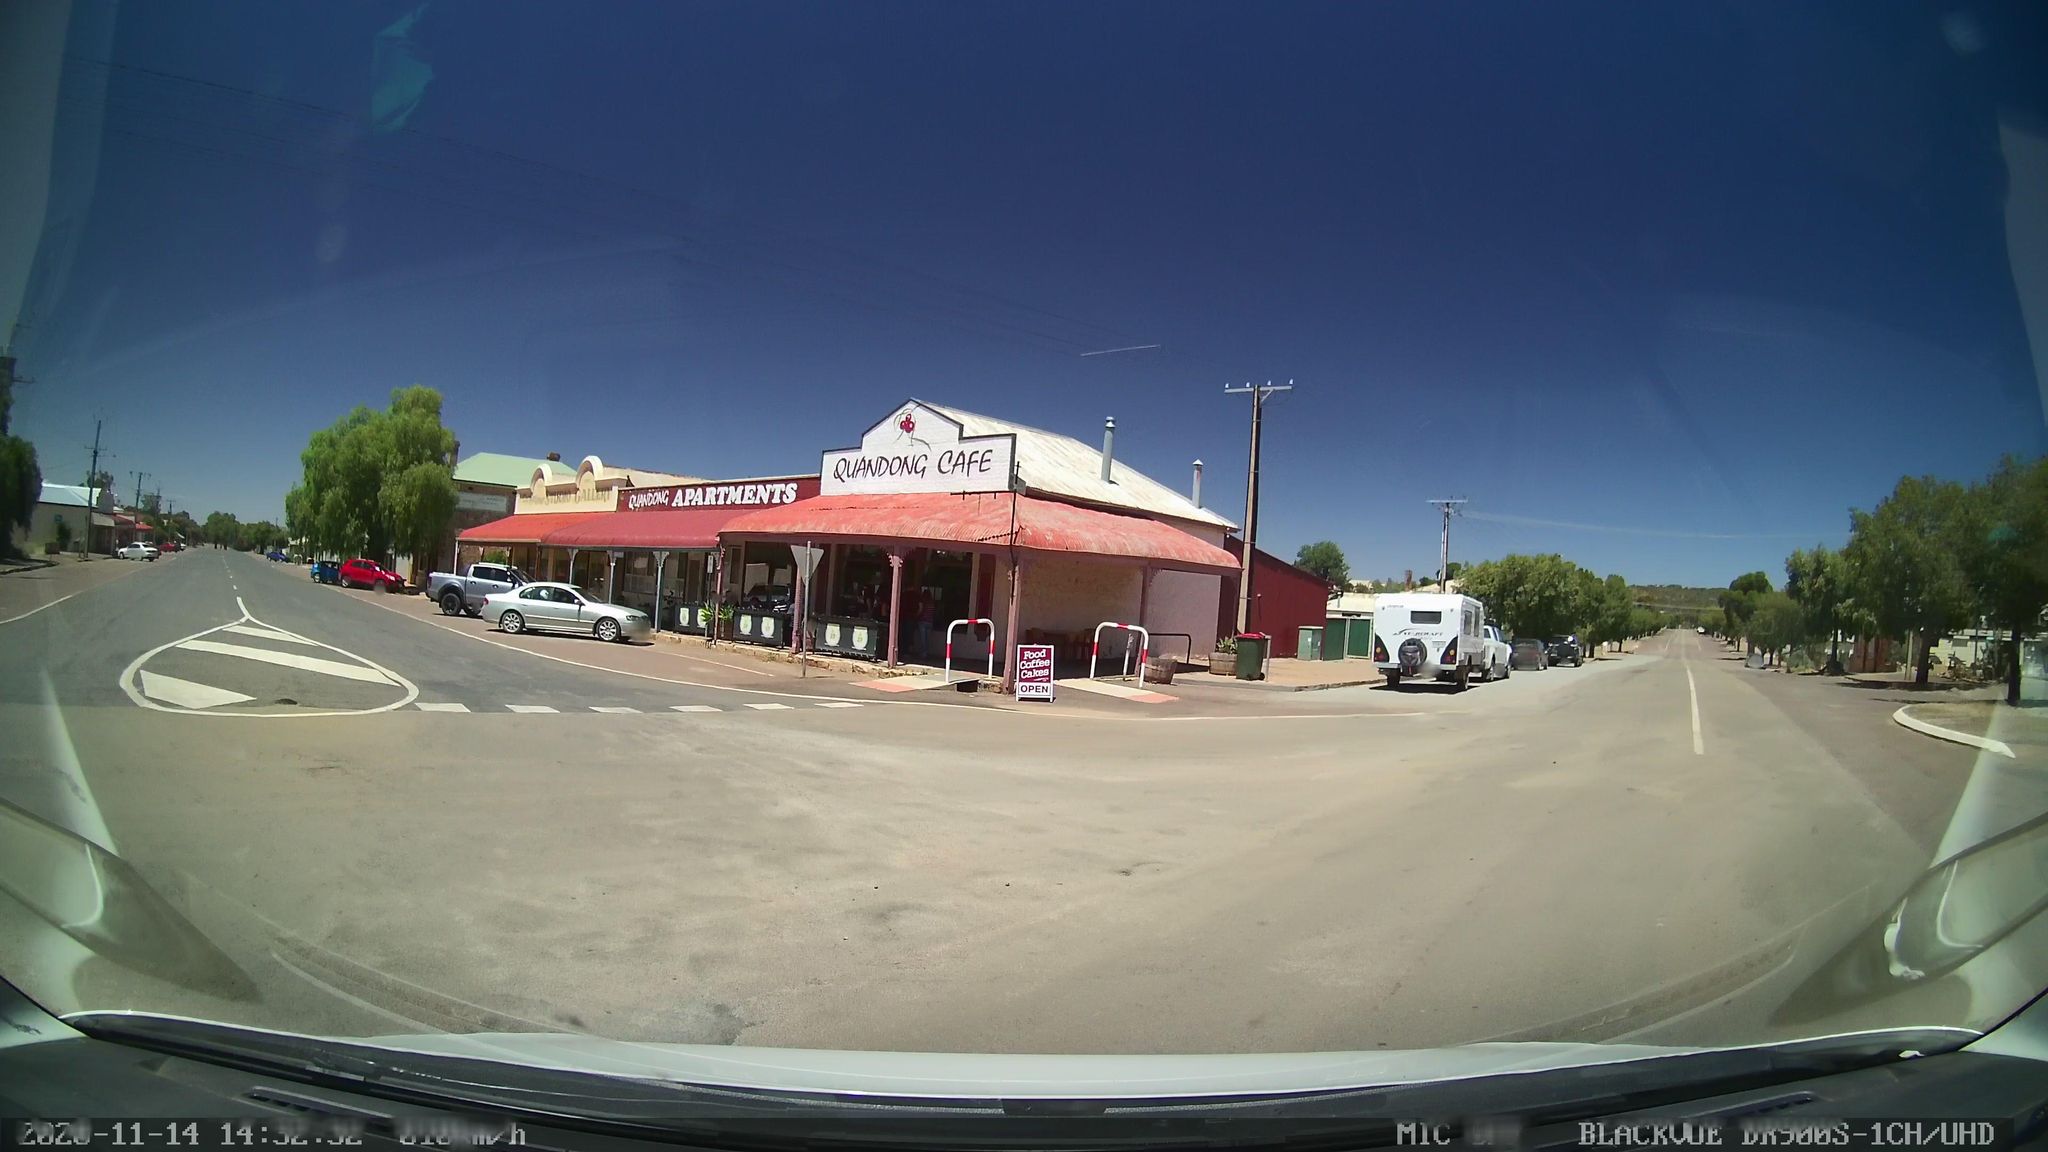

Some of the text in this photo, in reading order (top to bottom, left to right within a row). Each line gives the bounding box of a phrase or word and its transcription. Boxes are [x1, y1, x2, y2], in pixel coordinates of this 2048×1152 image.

[833, 449, 993, 482] QUANDONG CAFE
[628, 483, 798, 509] QUANDONG APARTMENTS
[1023, 649, 1046, 660] Food
[1020, 659, 1050, 670] Coffee
[1021, 669, 1049, 679] Cakes
[1020, 685, 1049, 693] OPEN
